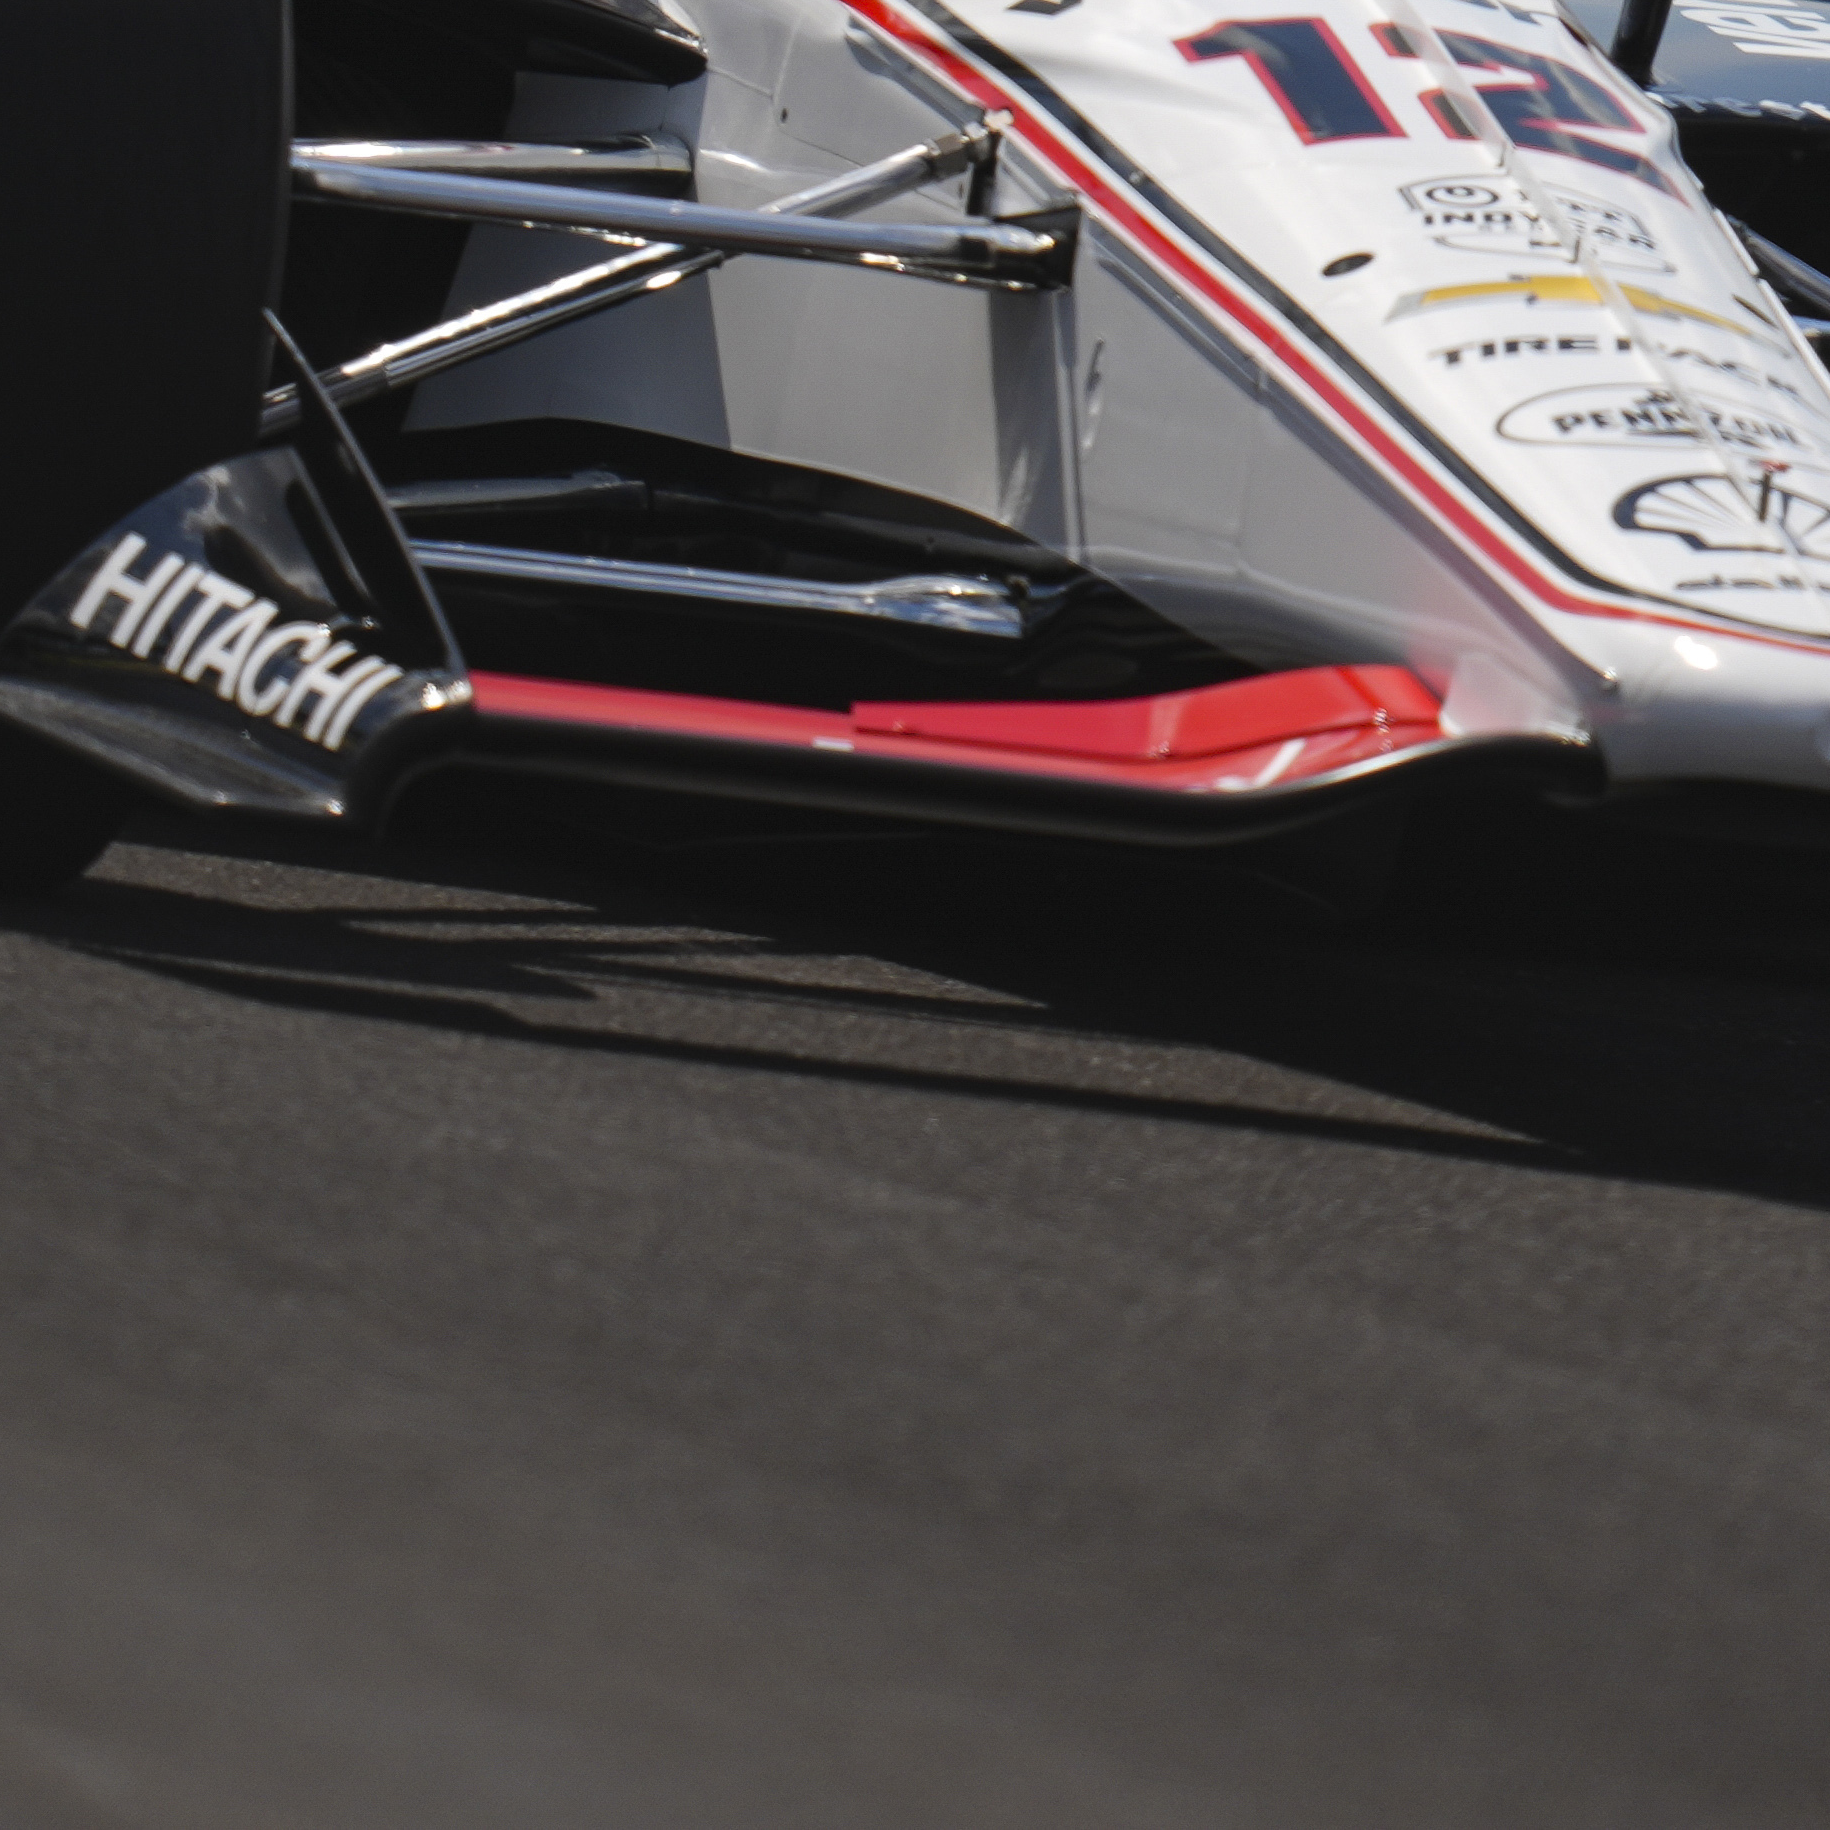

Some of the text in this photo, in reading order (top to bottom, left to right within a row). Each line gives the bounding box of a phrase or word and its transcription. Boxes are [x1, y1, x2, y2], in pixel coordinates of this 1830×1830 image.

[1173, 16, 1692, 208] 12
[1423, 208, 1658, 251] INDYAR
[1428, 333, 1602, 368] TIRE
[70, 532, 405, 752] HITACHI
